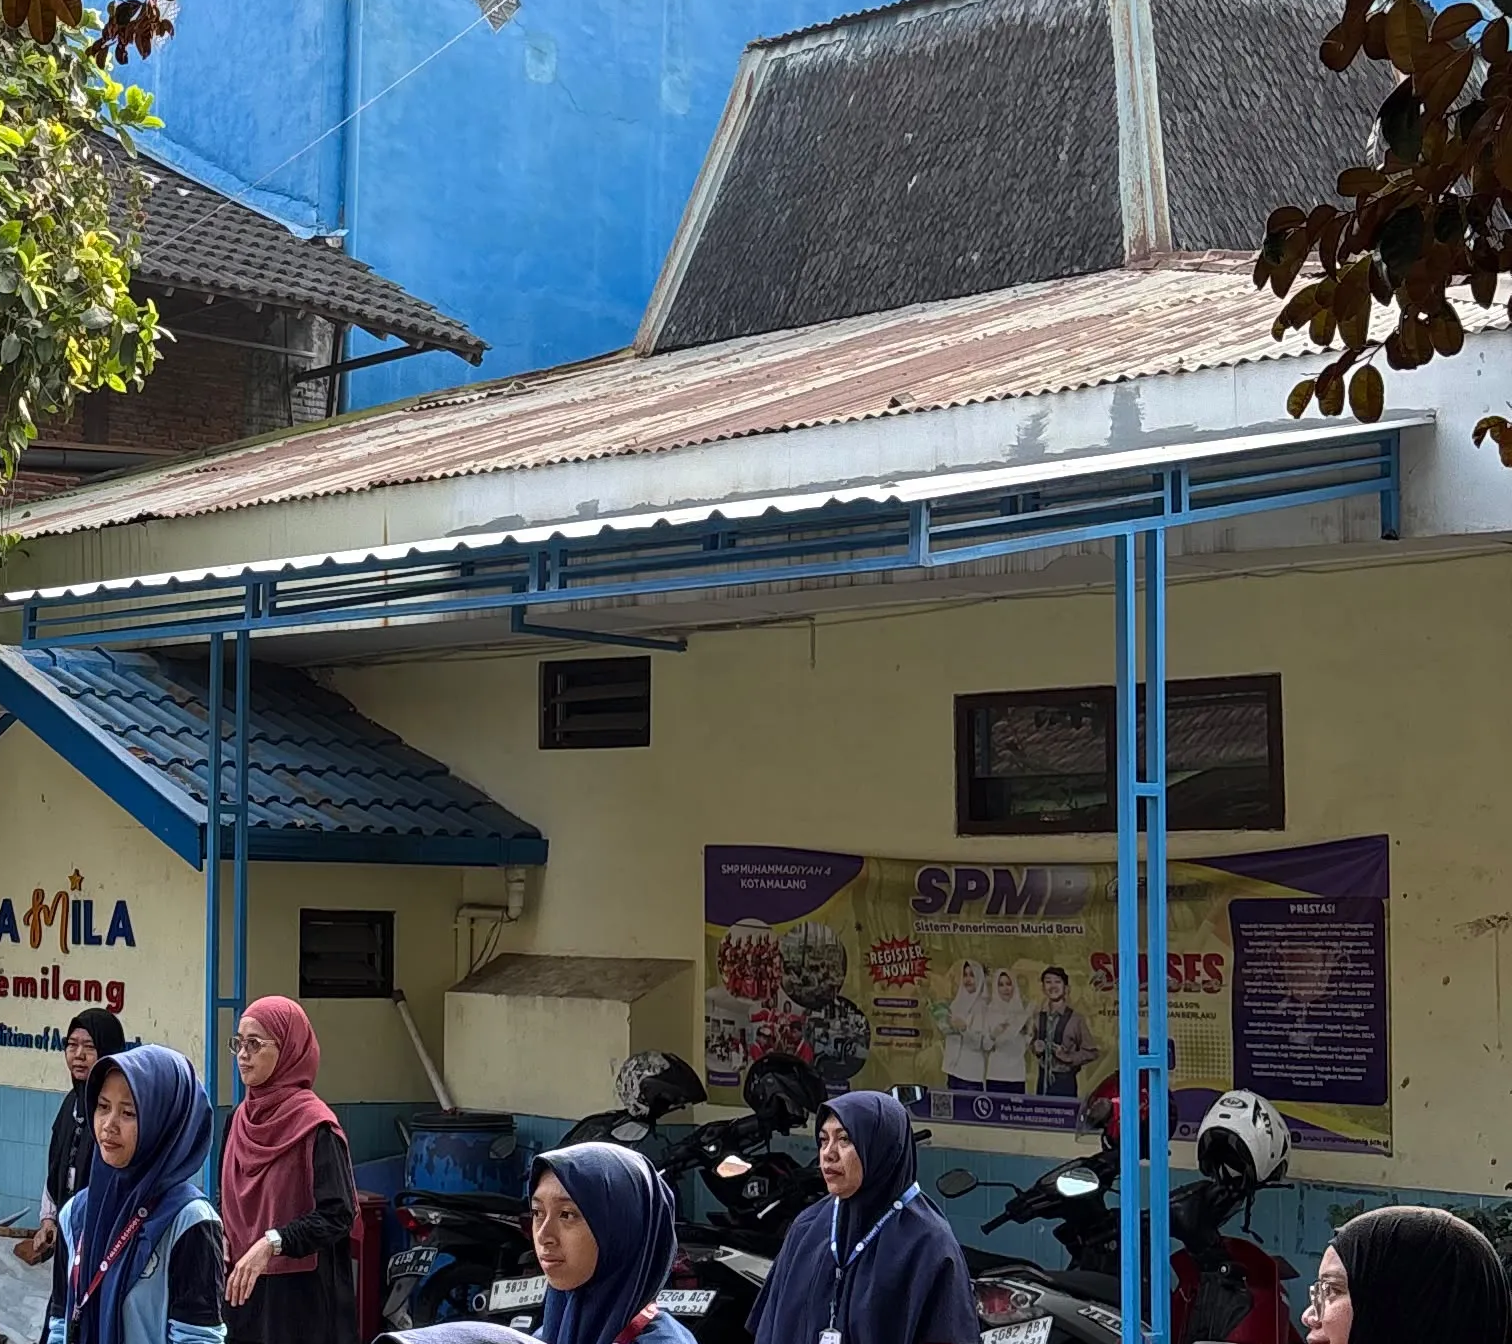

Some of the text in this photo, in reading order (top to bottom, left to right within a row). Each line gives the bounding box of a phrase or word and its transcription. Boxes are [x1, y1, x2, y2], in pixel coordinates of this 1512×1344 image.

[721, 864, 832, 876] SMP MUHAMMADIYAH 4
[740, 878, 807, 890] KOTA MALANG
[911, 866, 1089, 916] SPMB
[1289, 904, 1336, 914] PRESTASI
[915, 921, 1084, 935] Sistem Penerimaan Murid Baru
[870, 945, 924, 965] REGISTER
[1089, 952, 1224, 993] SSES
[34, 1026, 50, 1052] of
